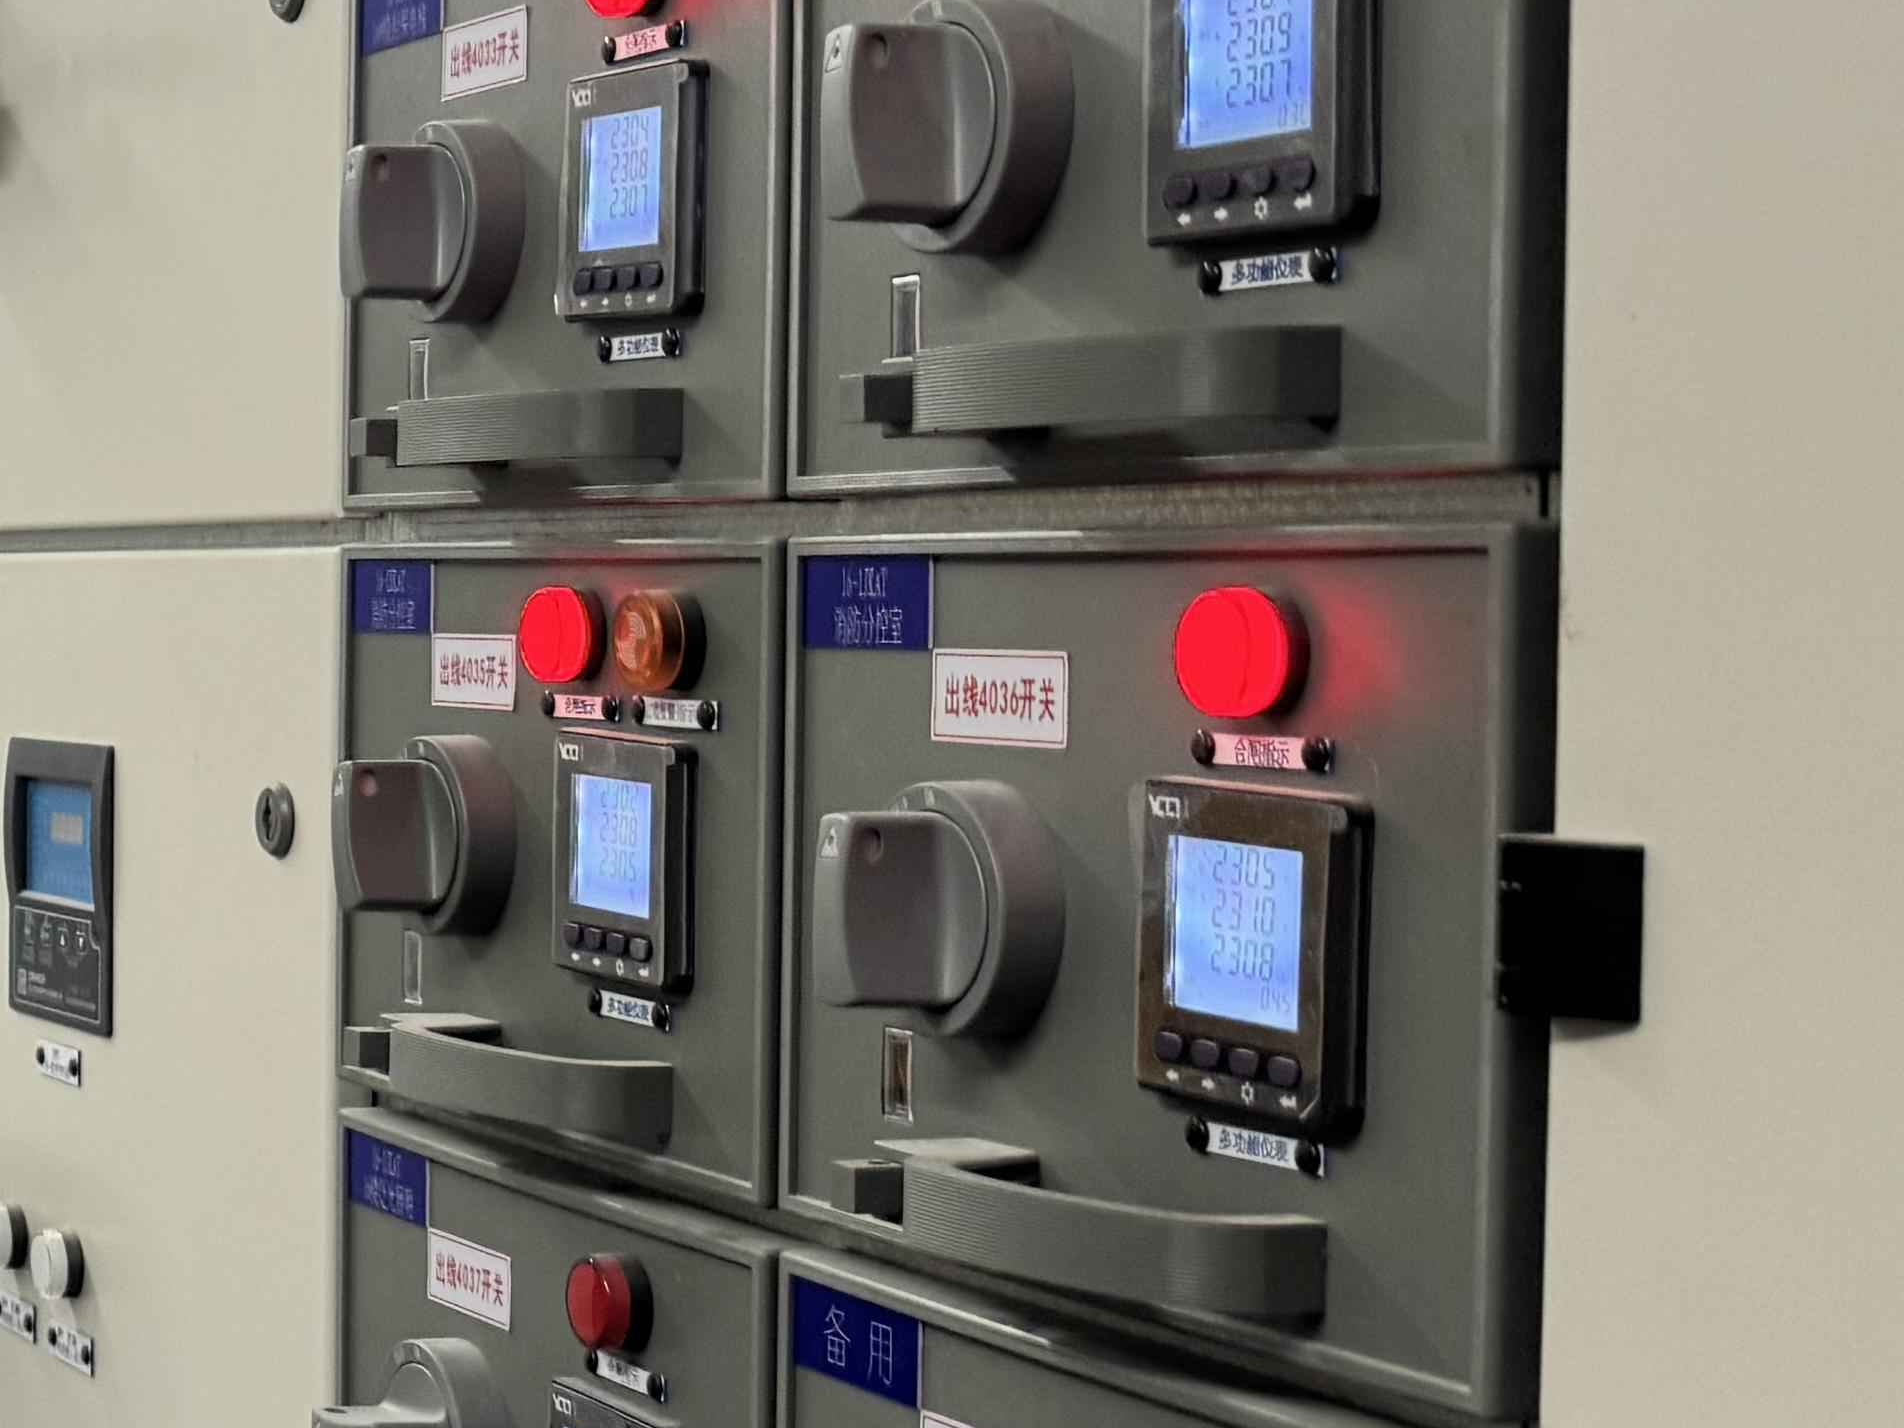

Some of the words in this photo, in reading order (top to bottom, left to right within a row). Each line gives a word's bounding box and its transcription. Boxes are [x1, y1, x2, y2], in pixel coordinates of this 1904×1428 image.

[449, 27, 520, 80] 出线4033开关
[944, 674, 1055, 722] 出线4036开关
[434, 1249, 505, 1308] 出线4037开关
[823, 1303, 893, 1387] 备用
